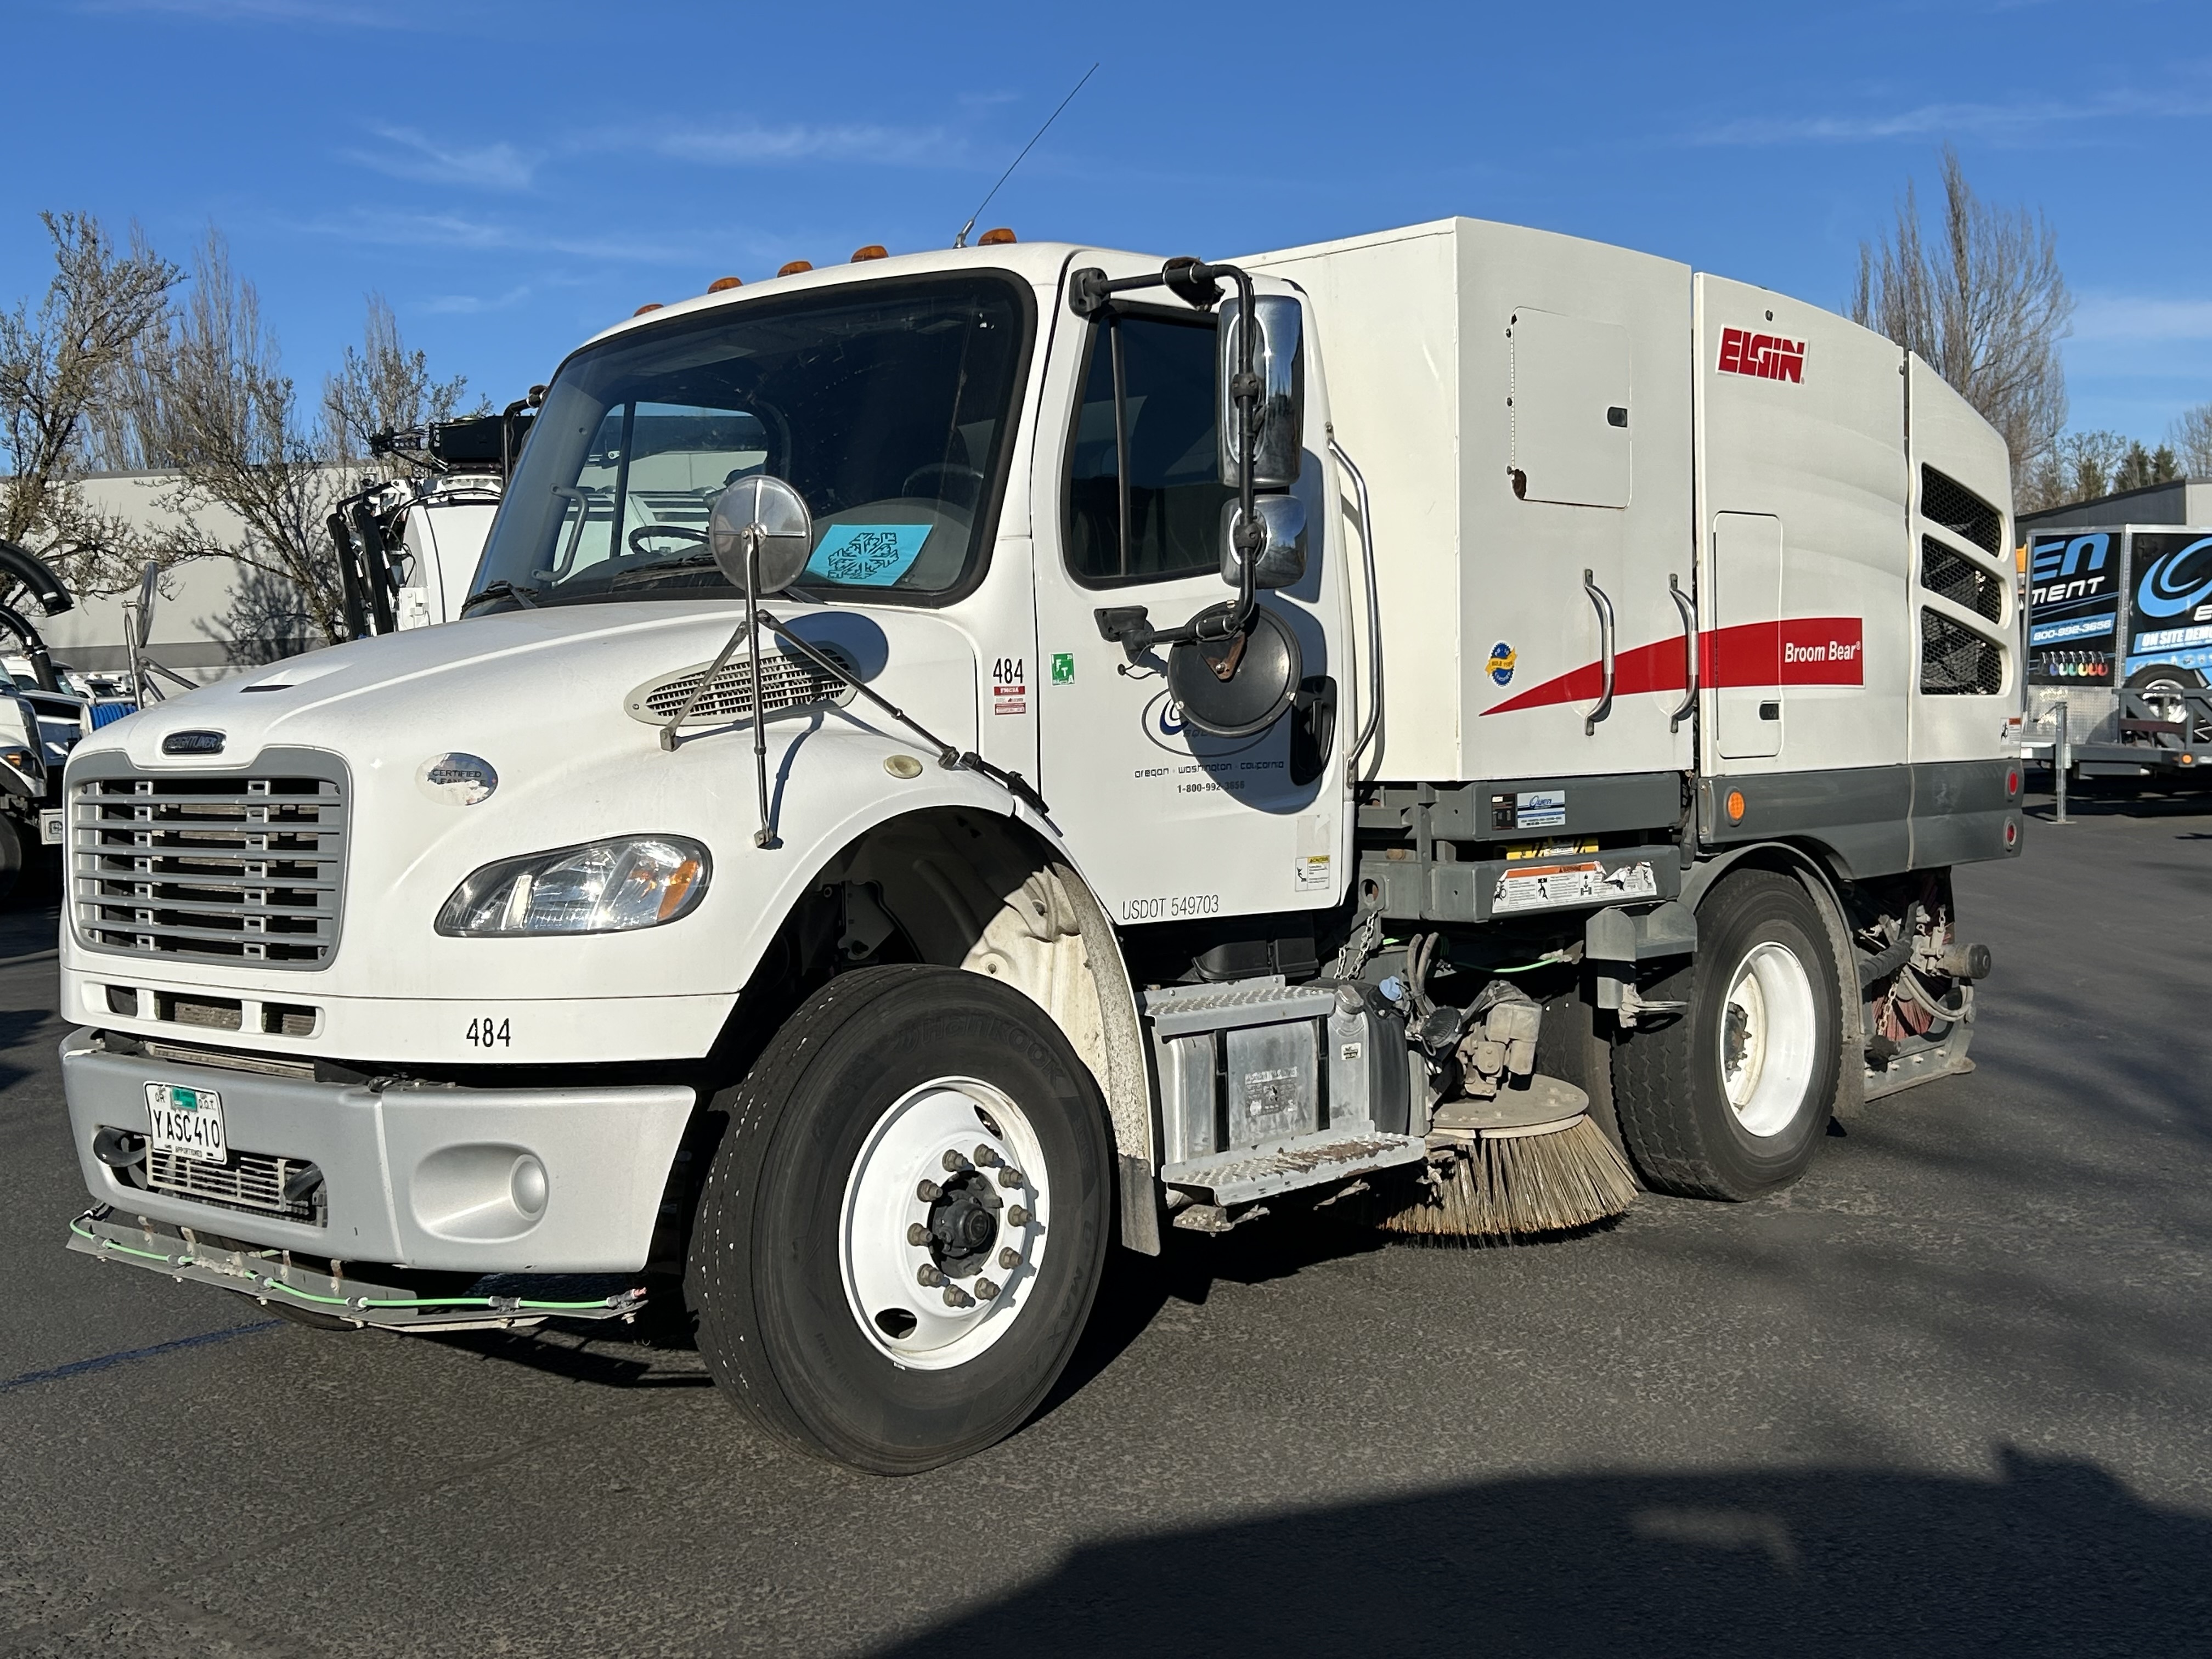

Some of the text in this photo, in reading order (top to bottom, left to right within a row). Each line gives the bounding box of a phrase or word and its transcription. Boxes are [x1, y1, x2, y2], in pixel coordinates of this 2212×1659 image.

[1718, 327, 1805, 384] ELGIN
[2142, 633, 2159, 647] ON
[2159, 629, 2185, 645] SITE
[1784, 642, 1826, 663] Broom
[992, 658, 1024, 684] 484
[432, 769, 482, 778] CERTIFIED
[1122, 894, 1219, 921] USDOT 549703
[466, 1017, 511, 1048] 484
[153, 1109, 220, 1148] YASC410
